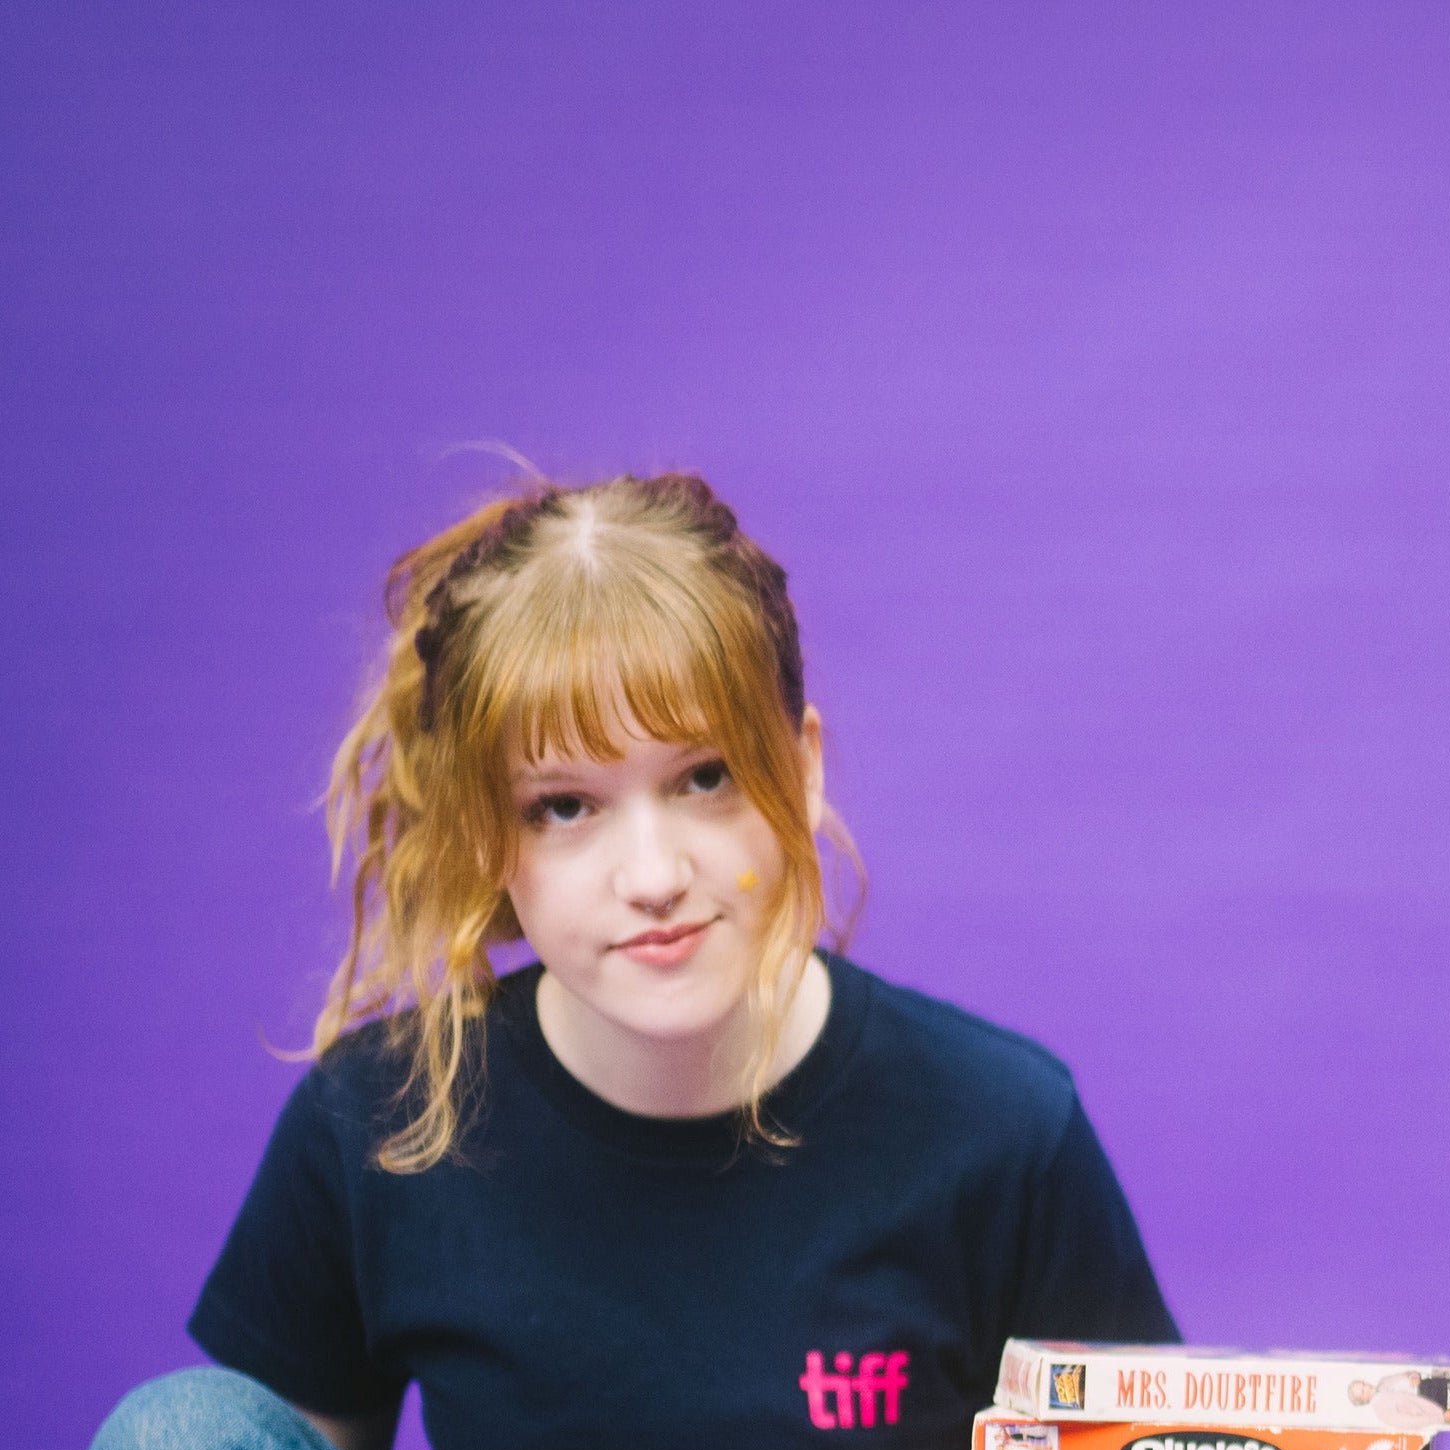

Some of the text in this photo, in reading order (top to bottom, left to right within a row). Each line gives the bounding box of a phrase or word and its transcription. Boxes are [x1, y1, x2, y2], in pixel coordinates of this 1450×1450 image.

[798, 1349, 910, 1430] tiff
[1116, 1369, 1171, 1409] MRS.
[1184, 1371, 1318, 1413] DOUBTFIRE
